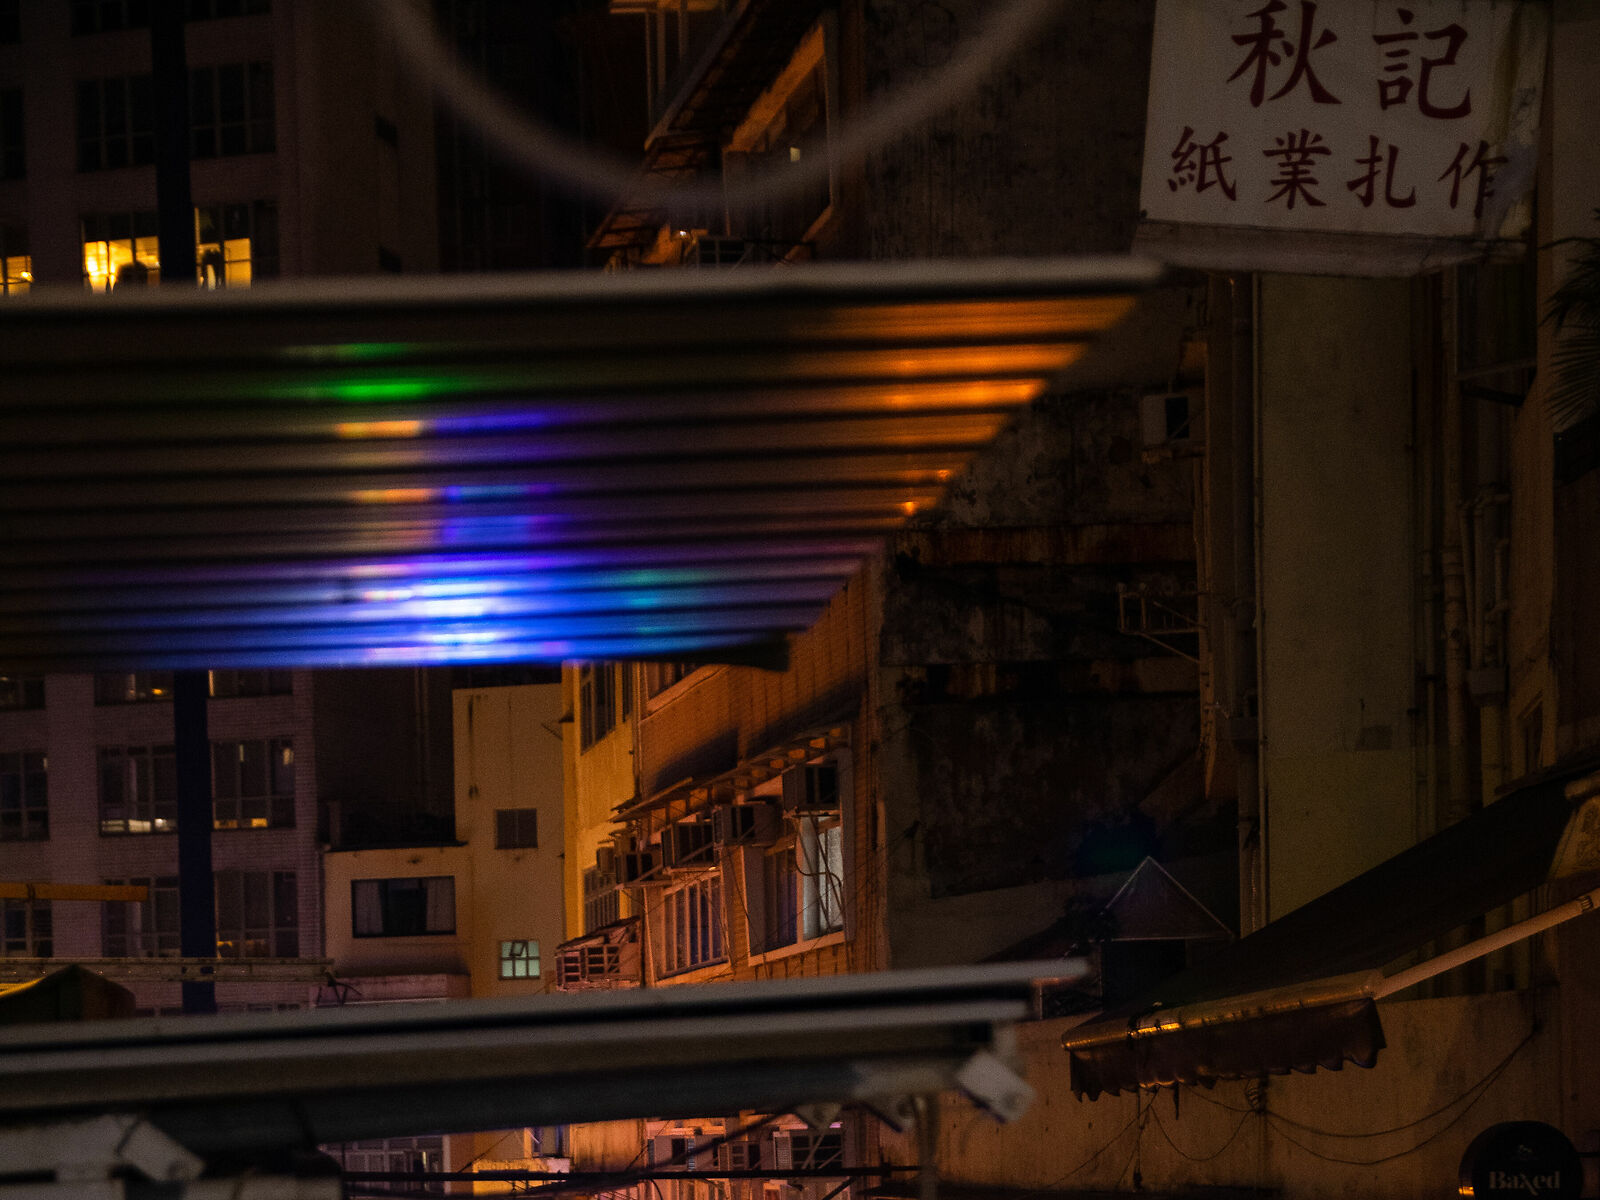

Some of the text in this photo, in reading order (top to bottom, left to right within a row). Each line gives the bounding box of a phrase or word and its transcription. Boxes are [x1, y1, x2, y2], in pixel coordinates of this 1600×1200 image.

[1227, 0, 1472, 119] 秋記
[1167, 127, 1509, 217] 紙業扎作
[1488, 1170, 1560, 1196] Baxed
